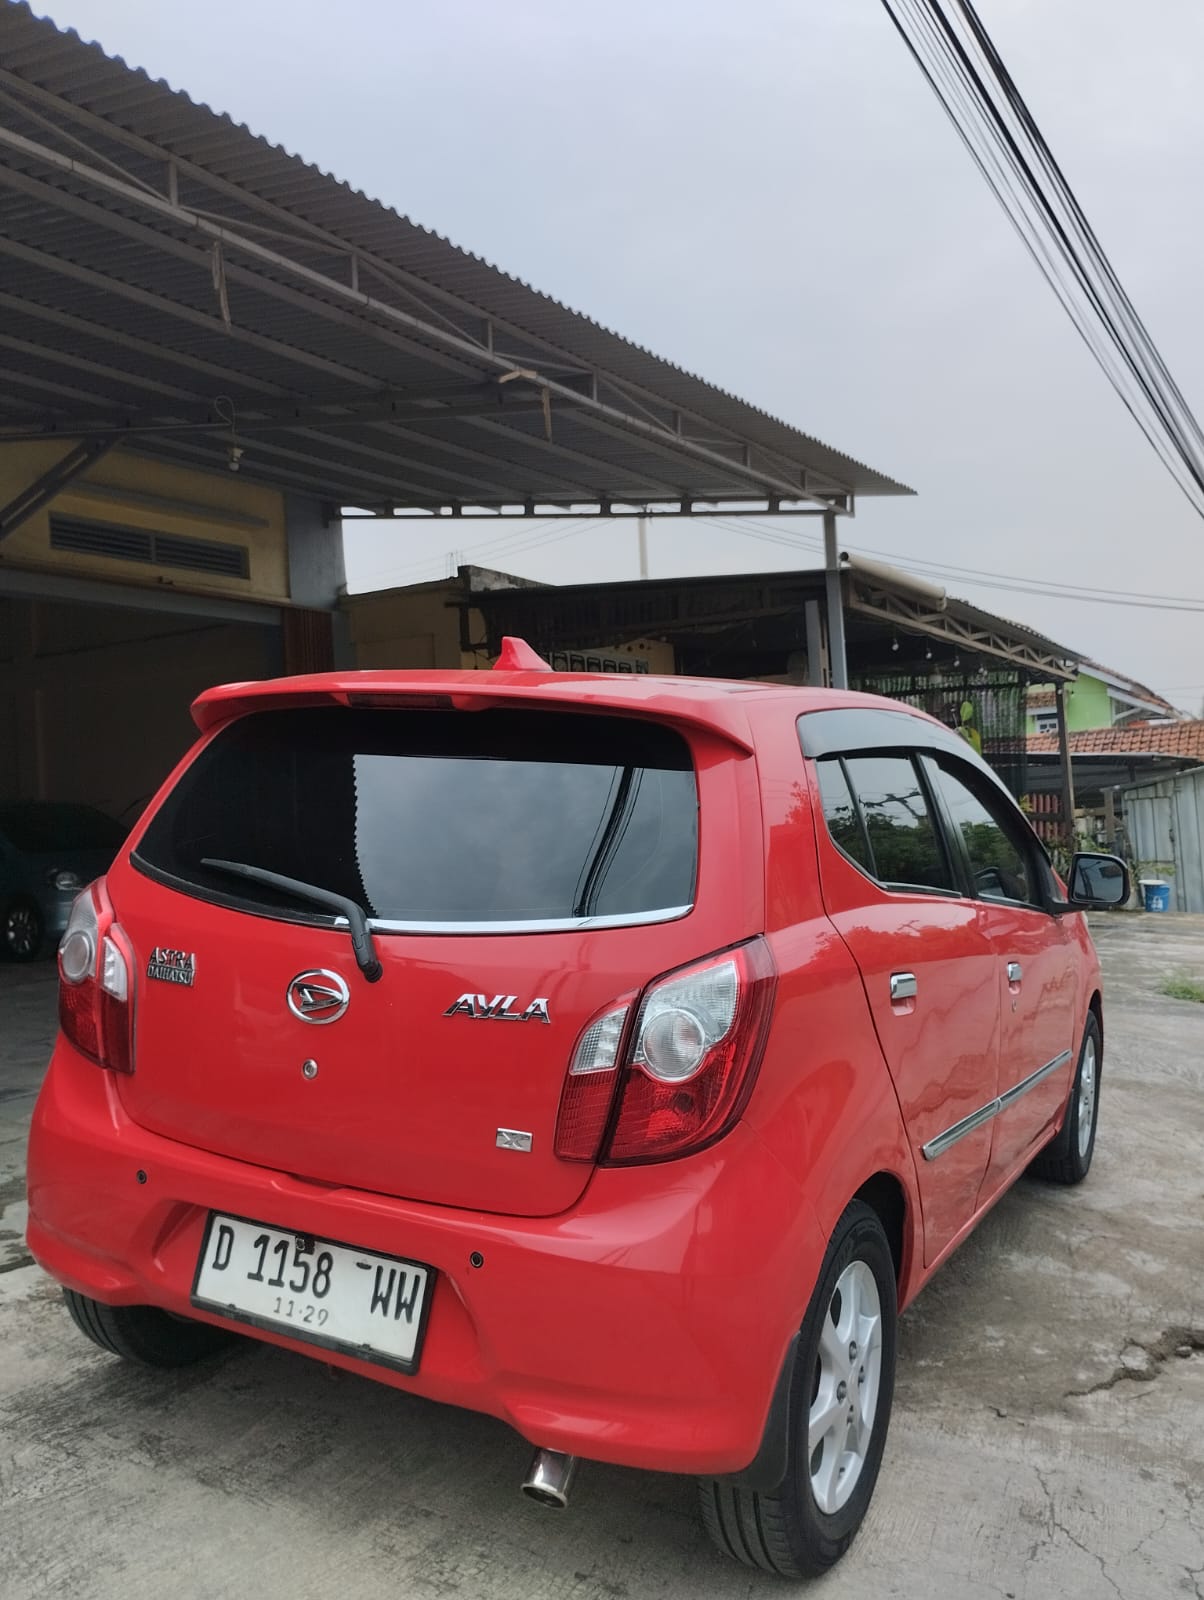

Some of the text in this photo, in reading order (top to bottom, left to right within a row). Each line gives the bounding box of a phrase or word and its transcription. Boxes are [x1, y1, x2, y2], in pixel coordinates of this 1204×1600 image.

[149, 946, 195, 970] ASTRA
[147, 964, 195, 986] DAIHATSU
[442, 993, 551, 1024] AYLA
[213, 1225, 421, 1324] D 1158 WW
